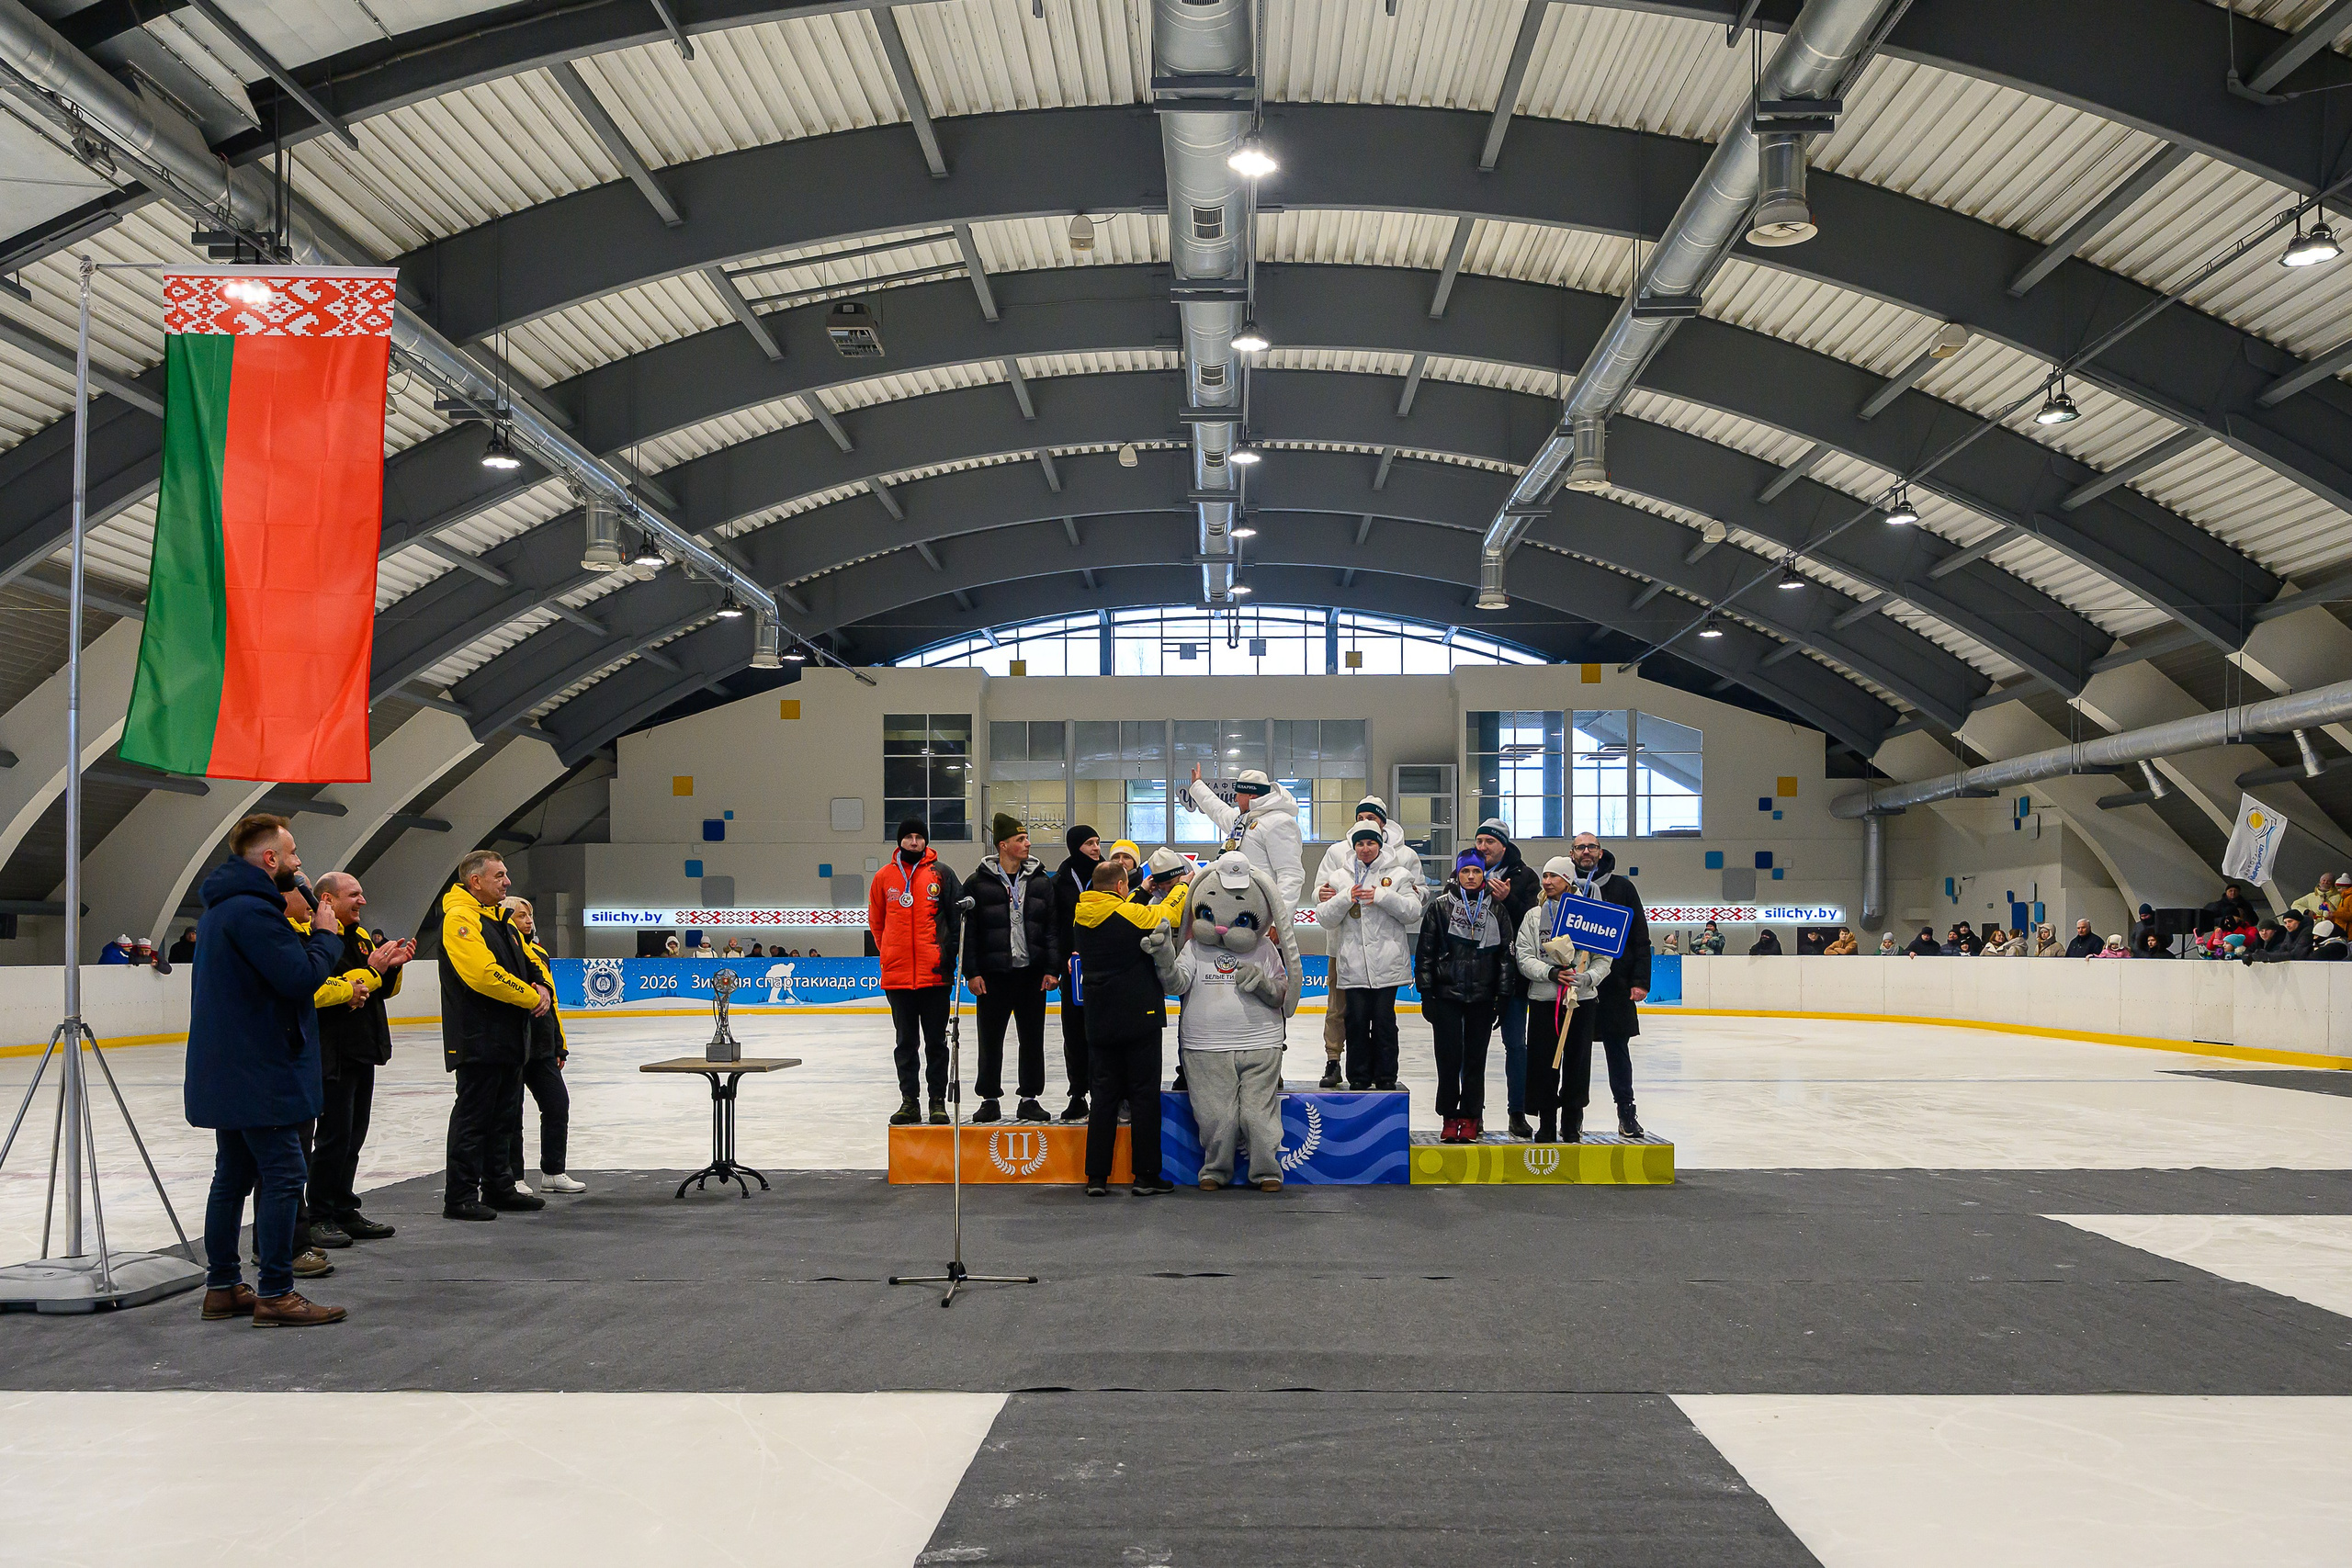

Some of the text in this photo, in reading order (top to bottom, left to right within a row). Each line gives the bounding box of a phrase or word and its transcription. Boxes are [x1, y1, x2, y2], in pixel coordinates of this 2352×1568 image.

[592, 911, 662, 924] silichy.by
[1765, 908, 1837, 920] silichy.by
[1566, 913, 1617, 938] Единые
[493, 970, 525, 994] BELARUS
[639, 975, 678, 989] 2026
[755, 976, 855, 990] спартакиада
[1004, 1133, 1033, 1160] II
[1531, 1149, 1554, 1166] III
